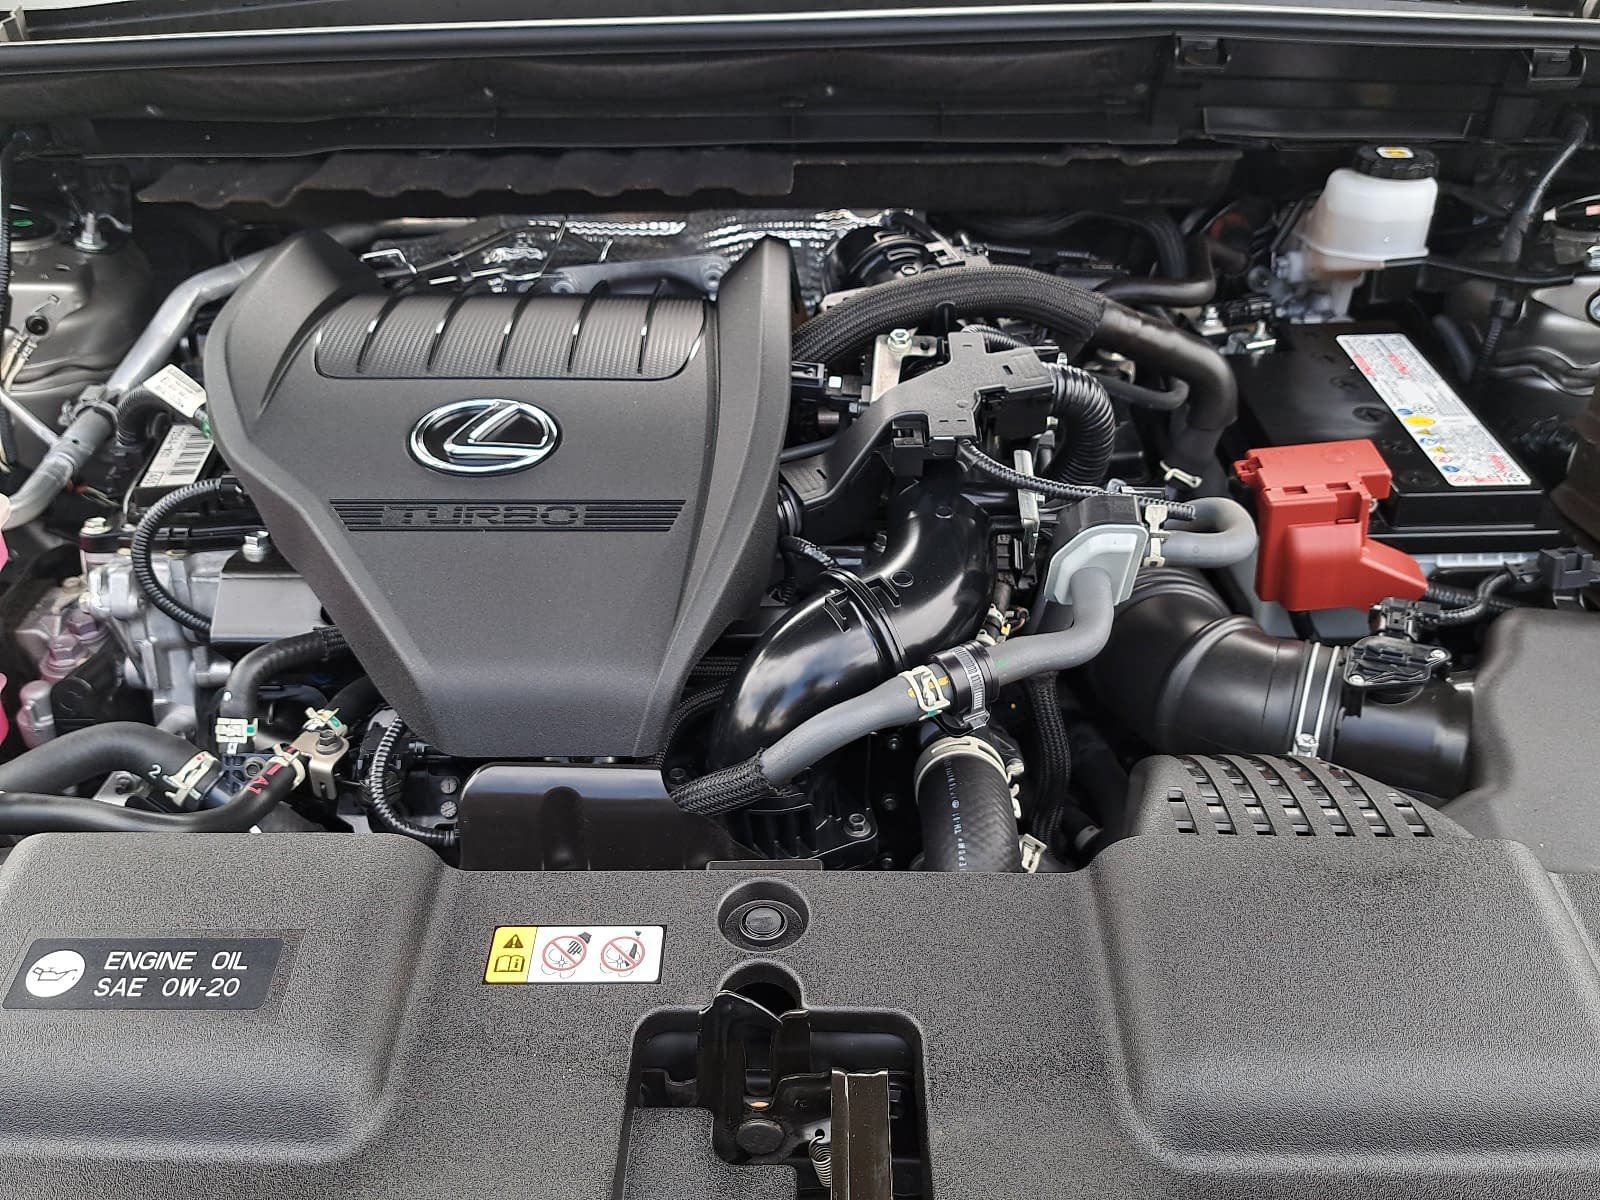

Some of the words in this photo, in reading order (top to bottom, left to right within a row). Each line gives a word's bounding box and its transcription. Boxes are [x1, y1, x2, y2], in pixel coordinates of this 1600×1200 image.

[390, 504, 579, 527] TURBO
[103, 951, 198, 970] ENGINE
[211, 951, 248, 970] OIL
[93, 977, 148, 997] SAE
[161, 977, 241, 998] 0W-20
